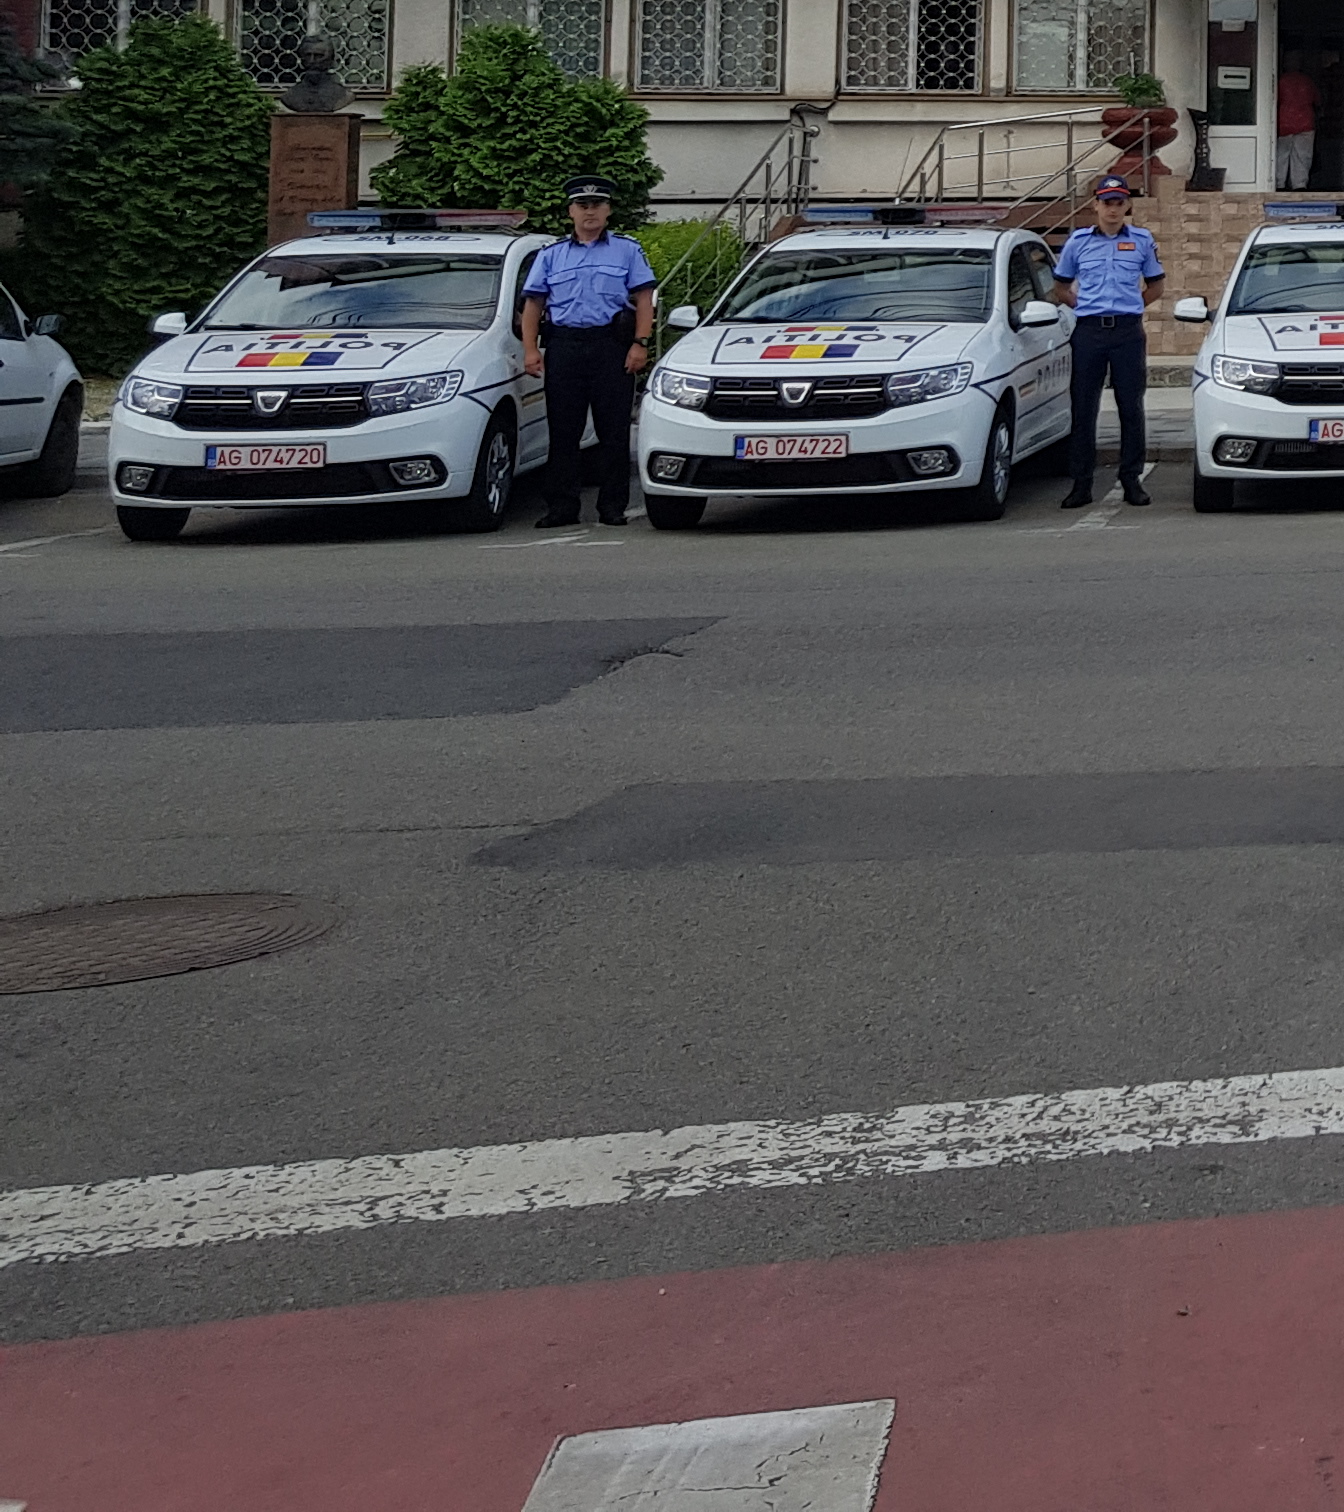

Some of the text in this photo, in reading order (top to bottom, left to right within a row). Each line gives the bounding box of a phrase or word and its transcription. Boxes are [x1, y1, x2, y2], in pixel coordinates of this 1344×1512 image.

[1321, 422, 1343, 438] AG
[745, 438, 843, 456] AG 074722
[217, 447, 321, 466] AG 074720
